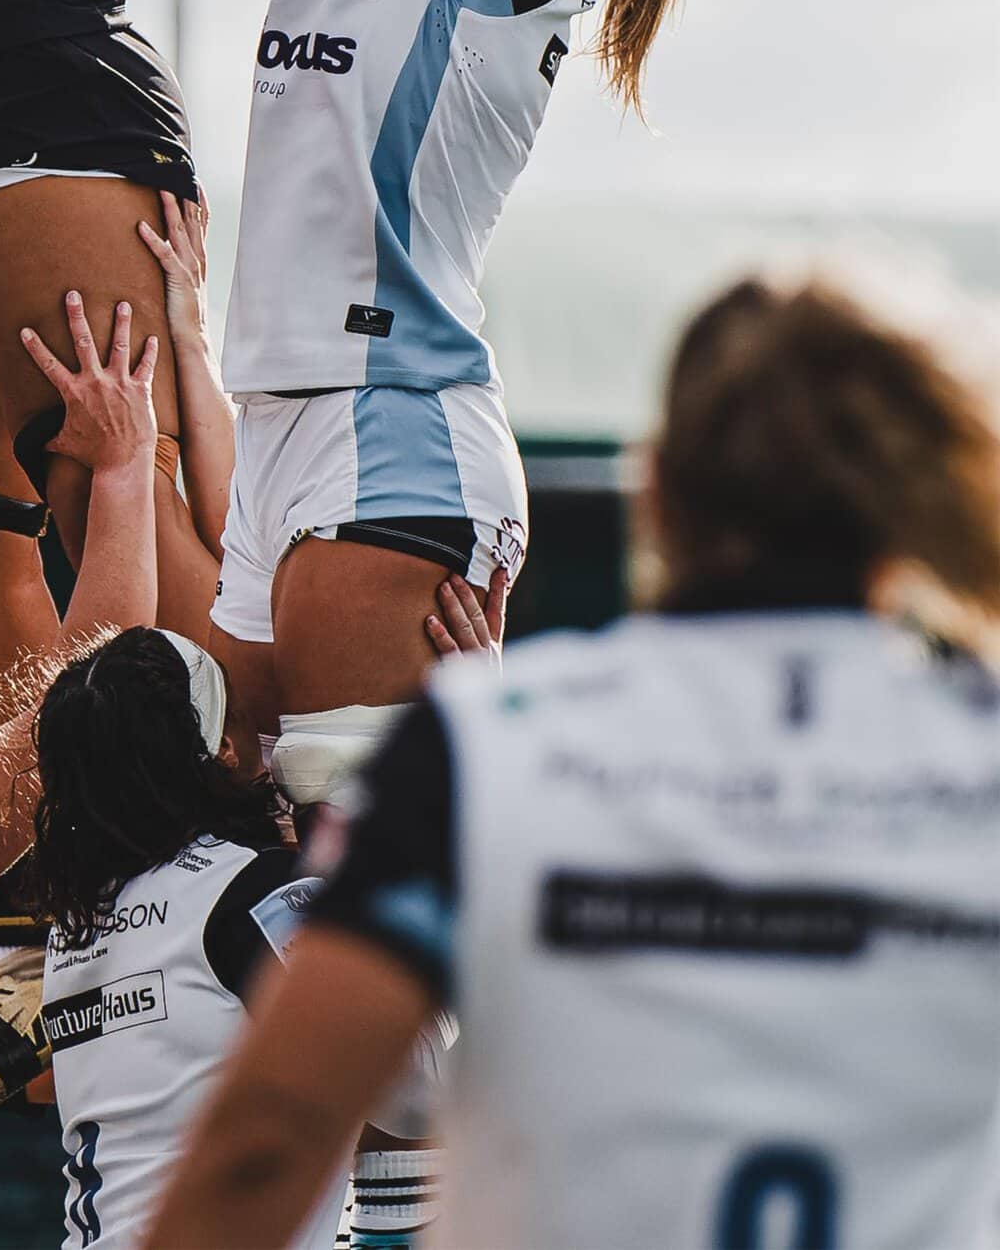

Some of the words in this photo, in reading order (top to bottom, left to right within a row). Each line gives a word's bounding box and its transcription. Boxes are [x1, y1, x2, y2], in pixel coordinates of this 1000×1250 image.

[257, 30, 357, 75] ocus
[254, 80, 286, 99] roup
[100, 901, 169, 939] DSON
[45, 987, 156, 1042] ructureHaus
